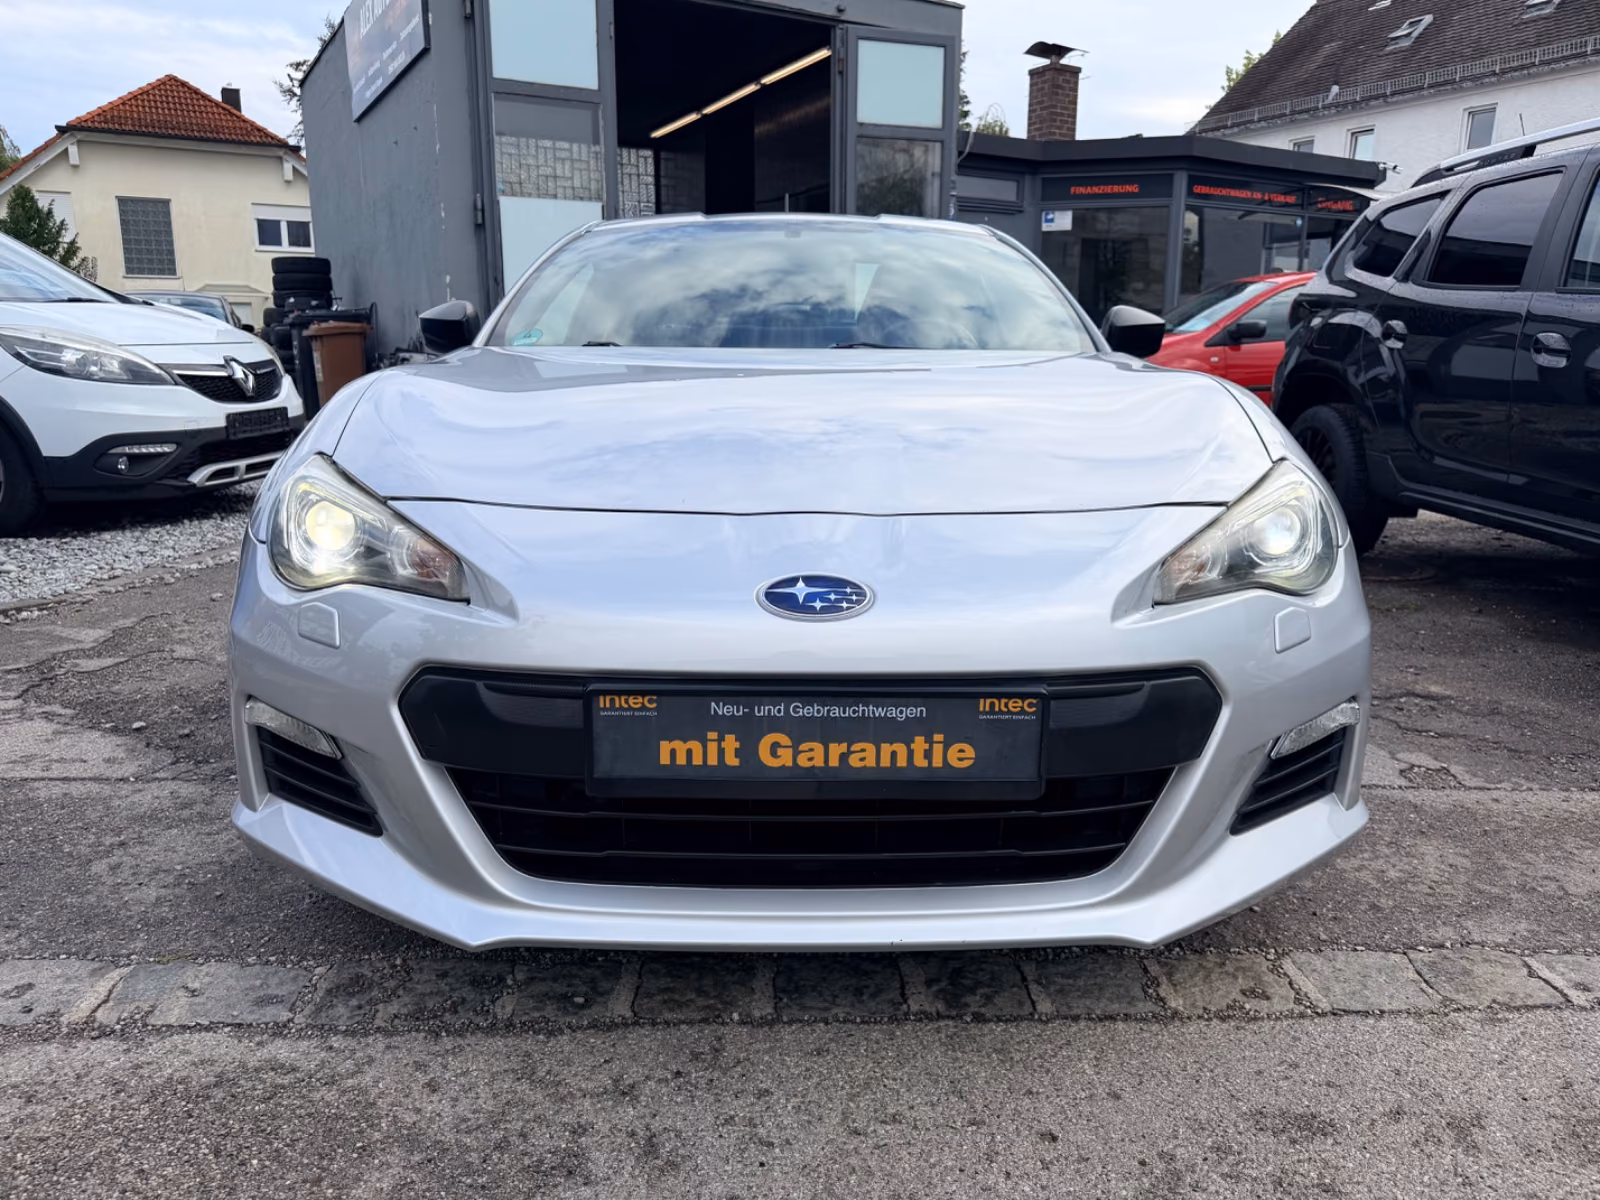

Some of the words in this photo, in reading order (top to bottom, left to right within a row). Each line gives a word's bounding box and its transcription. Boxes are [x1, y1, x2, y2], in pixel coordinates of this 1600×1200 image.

[1070, 184, 1139, 195] FINANZIERUNG
[1193, 185, 1251, 198] GEBRAUCHTWAGEN
[1270, 193, 1297, 204] VERKAUF
[599, 695, 657, 708] intec
[979, 698, 1037, 712] intec
[710, 701, 749, 716] Neu-
[754, 702, 784, 717] und
[789, 702, 927, 721] Gebrauchtwagen
[659, 731, 740, 766] mit
[758, 732, 976, 768] Garantie
